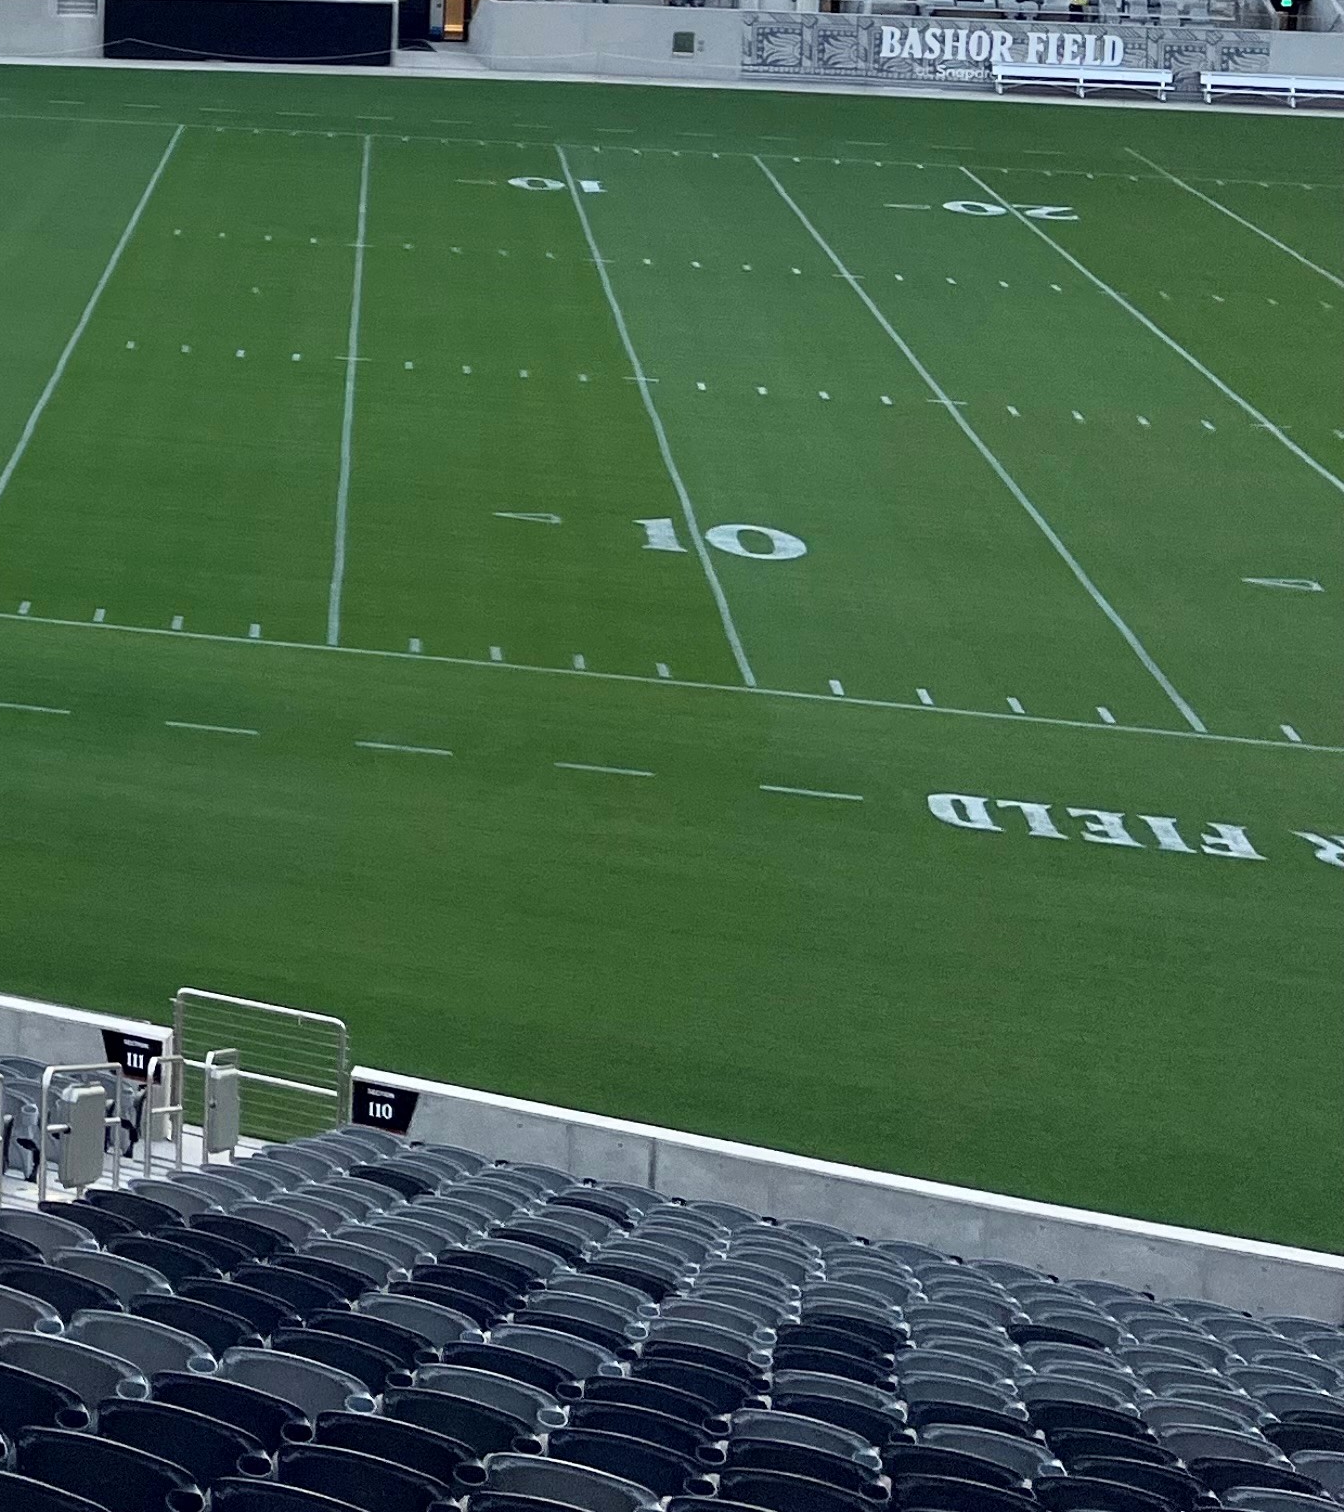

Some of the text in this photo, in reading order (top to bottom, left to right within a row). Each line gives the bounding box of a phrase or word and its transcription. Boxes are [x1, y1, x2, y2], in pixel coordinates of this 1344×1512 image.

[880, 25, 1124, 66] BASHOR FIELD
[632, 517, 807, 560] 10
[927, 794, 1268, 861] FIELD
[127, 1052, 144, 1069] 111
[369, 1101, 393, 1120] 110
